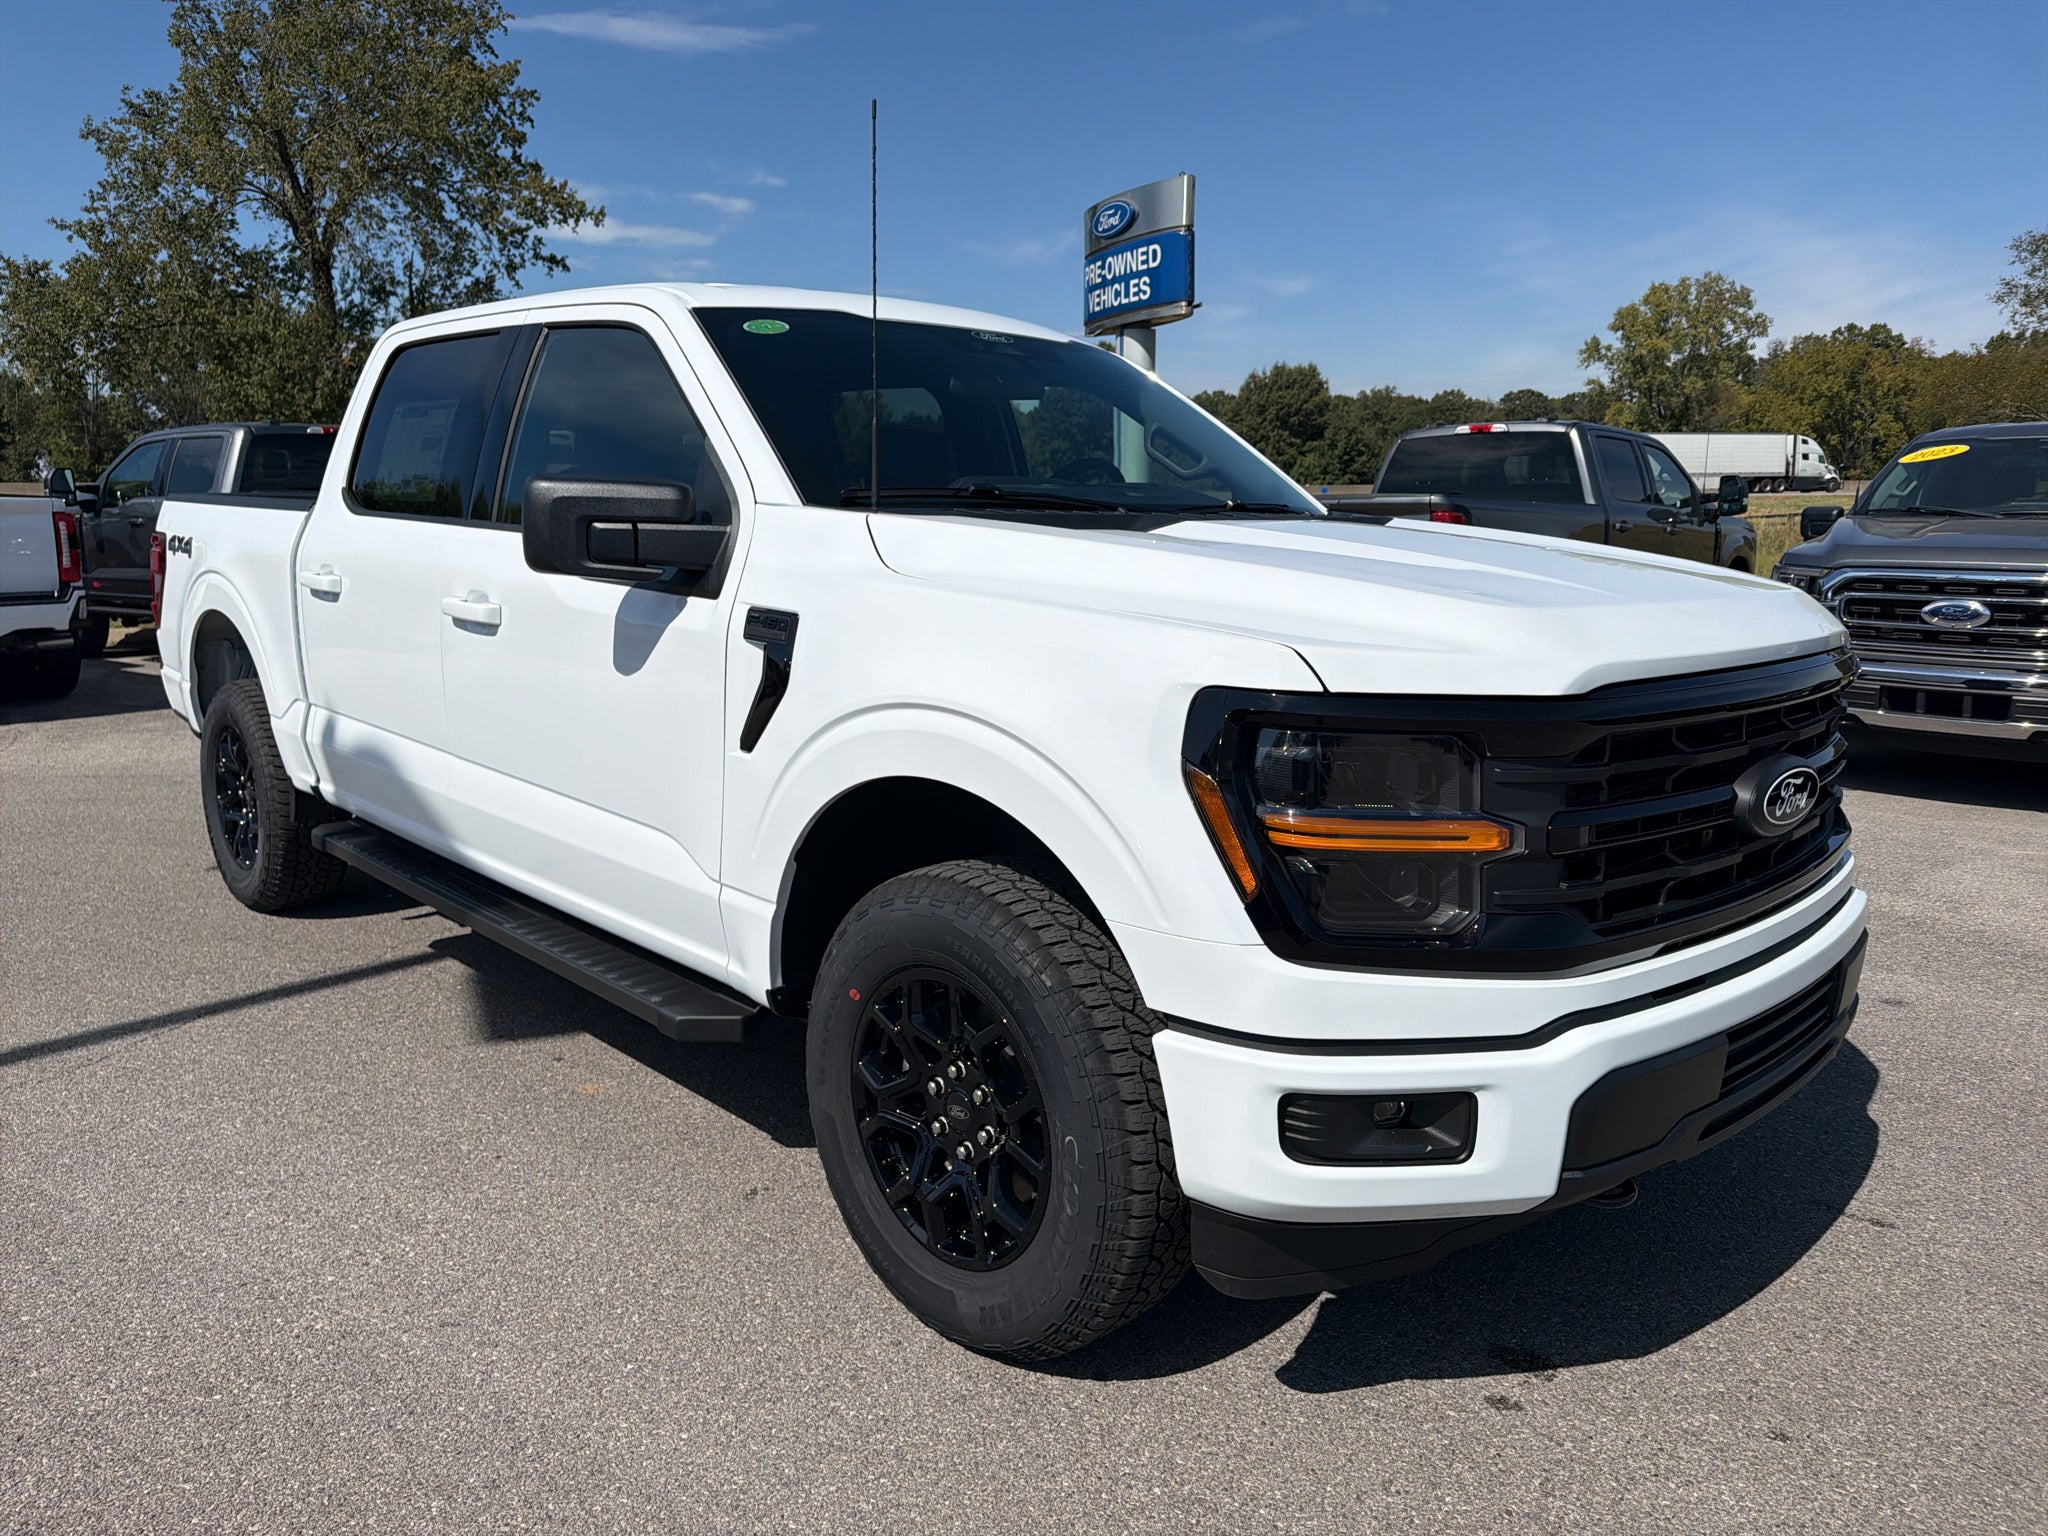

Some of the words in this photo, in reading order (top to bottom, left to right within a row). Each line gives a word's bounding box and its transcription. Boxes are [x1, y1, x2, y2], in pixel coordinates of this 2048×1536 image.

[1097, 208, 1121, 232] Ford
[1088, 275, 1151, 314] VEHICLES
[1909, 446, 1960, 461] 2023
[1775, 776, 1812, 818] Ford
